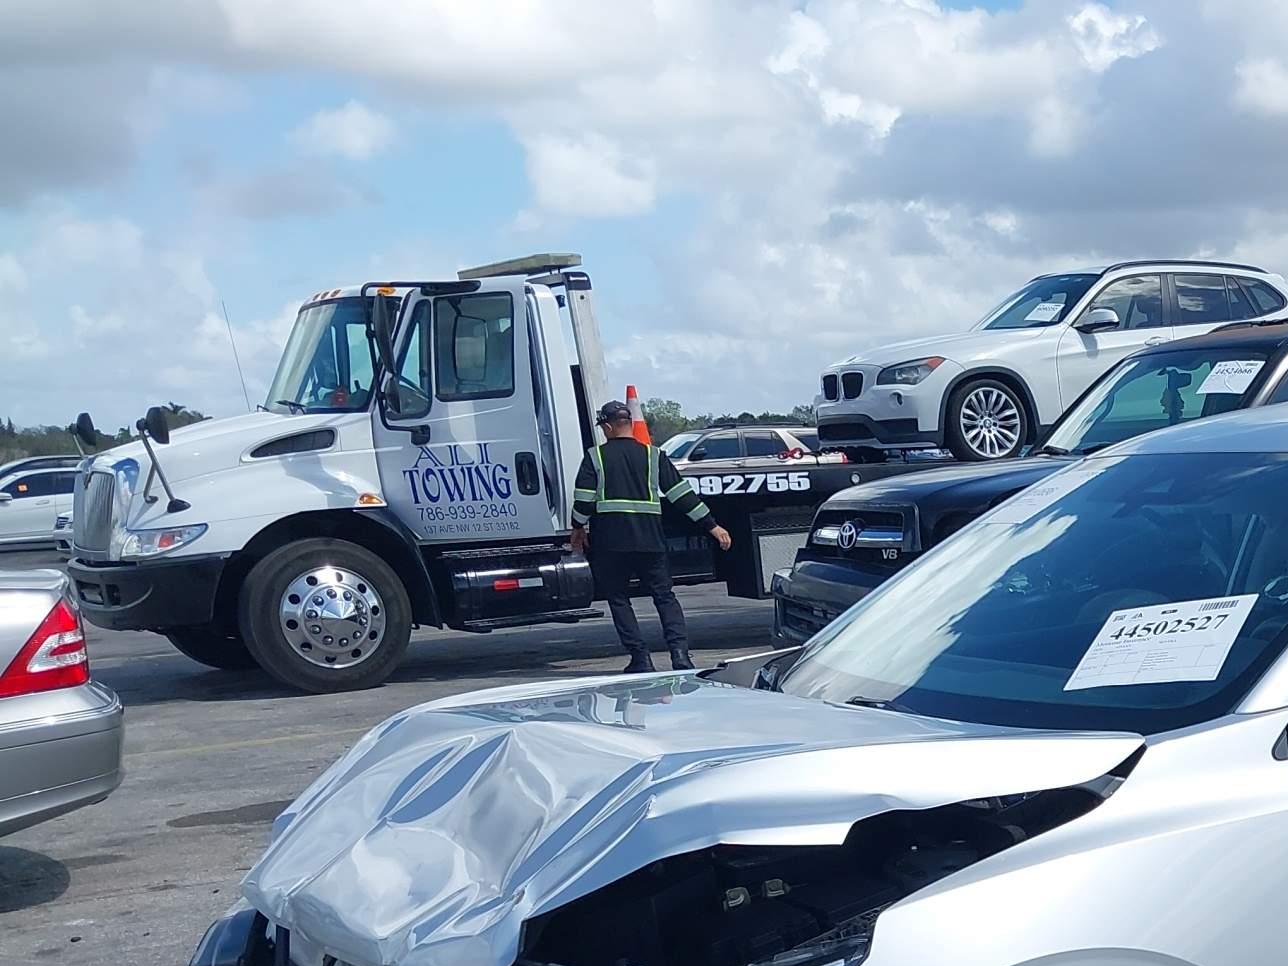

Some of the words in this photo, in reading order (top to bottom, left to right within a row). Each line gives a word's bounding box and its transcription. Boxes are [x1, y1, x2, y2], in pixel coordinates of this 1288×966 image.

[411, 443, 493, 468] ALI
[403, 464, 512, 505] TOWING
[417, 503, 518, 521] 786-939-2840
[423, 526, 437, 535] 137
[440, 524, 454, 533] AVE
[456, 523, 470, 533] NW
[472, 523, 481, 532] 12
[484, 523, 495, 531] ST
[496, 521, 521, 531] 33182
[882, 548, 898, 560] V8
[1109, 614, 1230, 641] 44502527
